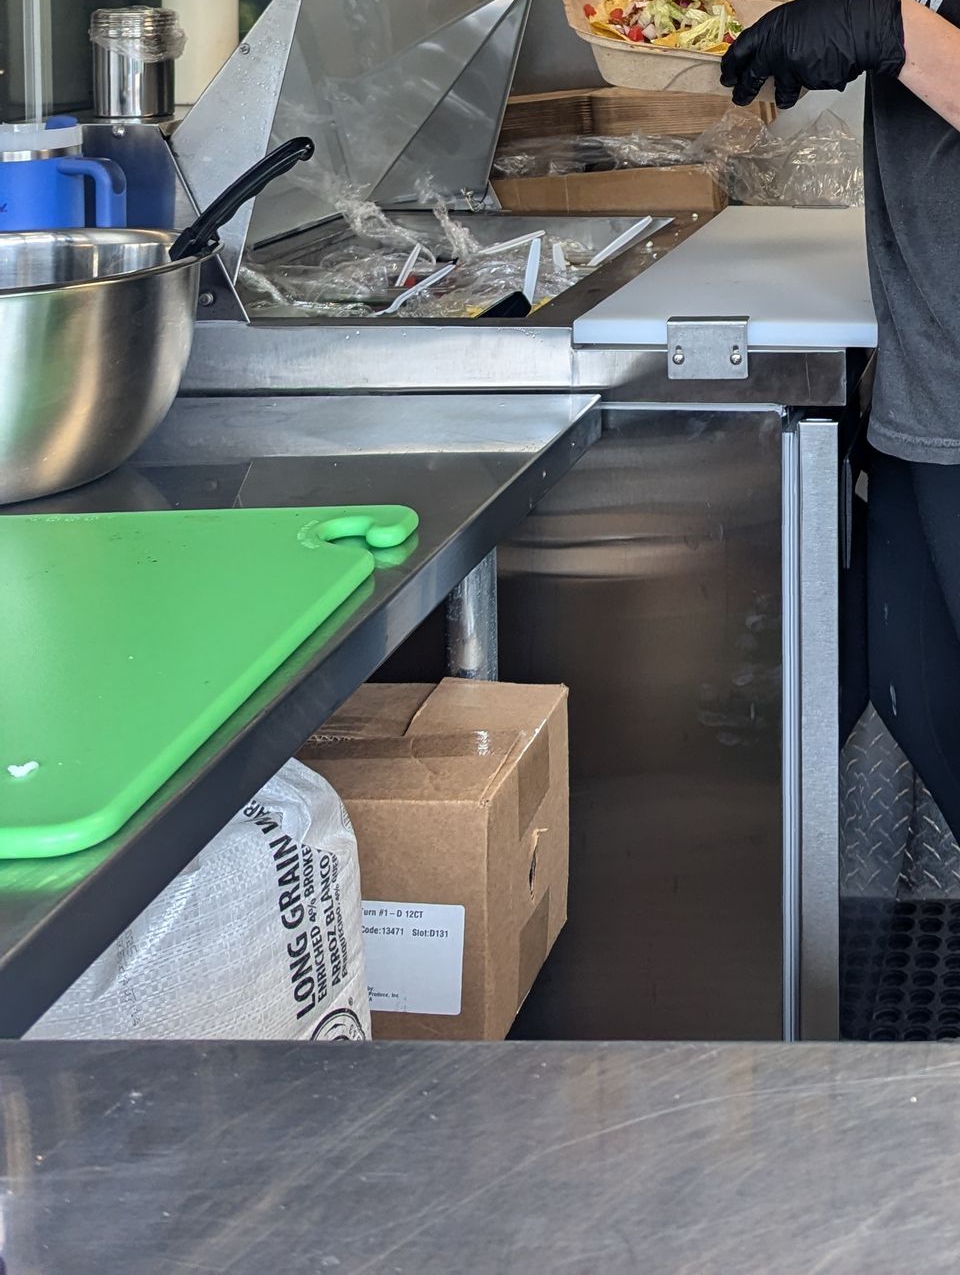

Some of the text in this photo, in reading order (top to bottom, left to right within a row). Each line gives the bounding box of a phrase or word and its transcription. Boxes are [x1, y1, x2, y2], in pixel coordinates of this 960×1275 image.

[268, 834, 306, 930] GRAIN
[301, 843, 328, 1003] ENRICHED 4% BROKE
[318, 853, 342, 987] ARROZ BLANCO
[361, 908, 377, 916] urn
[405, 910, 424, 919] 12CT
[286, 931, 316, 1021] LONG
[412, 928, 449, 938] Slot:D131
